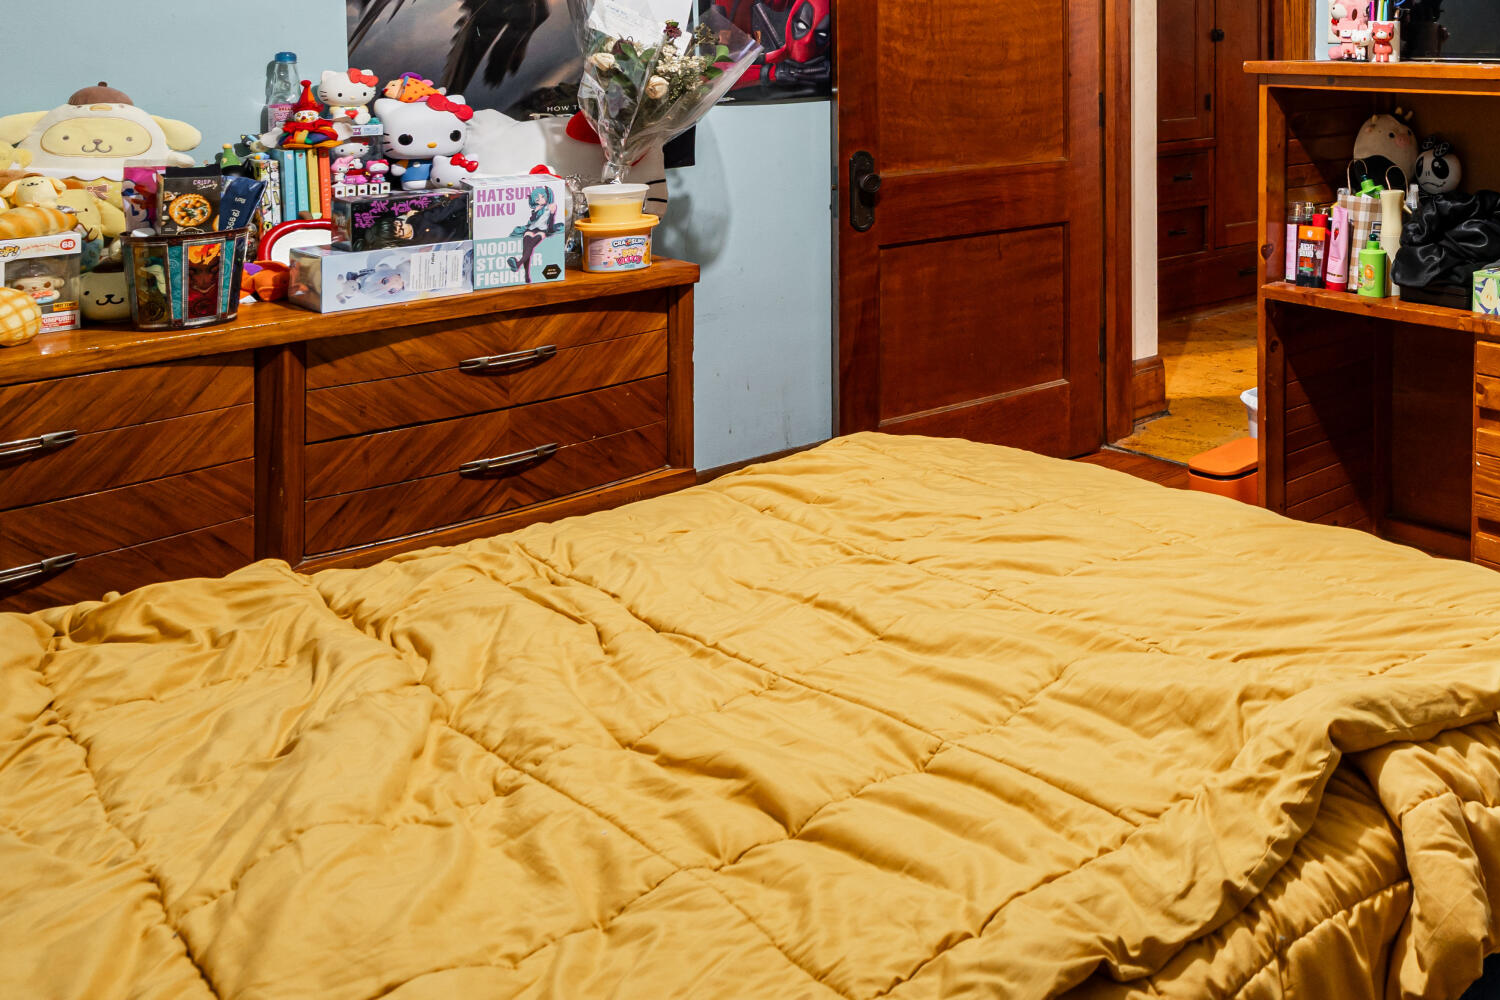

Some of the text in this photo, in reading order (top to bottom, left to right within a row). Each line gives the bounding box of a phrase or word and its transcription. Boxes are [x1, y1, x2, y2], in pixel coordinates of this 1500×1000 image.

[546, 105, 570, 113] HOW
[476, 185, 544, 203] HATSUN
[476, 202, 516, 218] MIKU
[476, 239, 524, 257] NOODL
